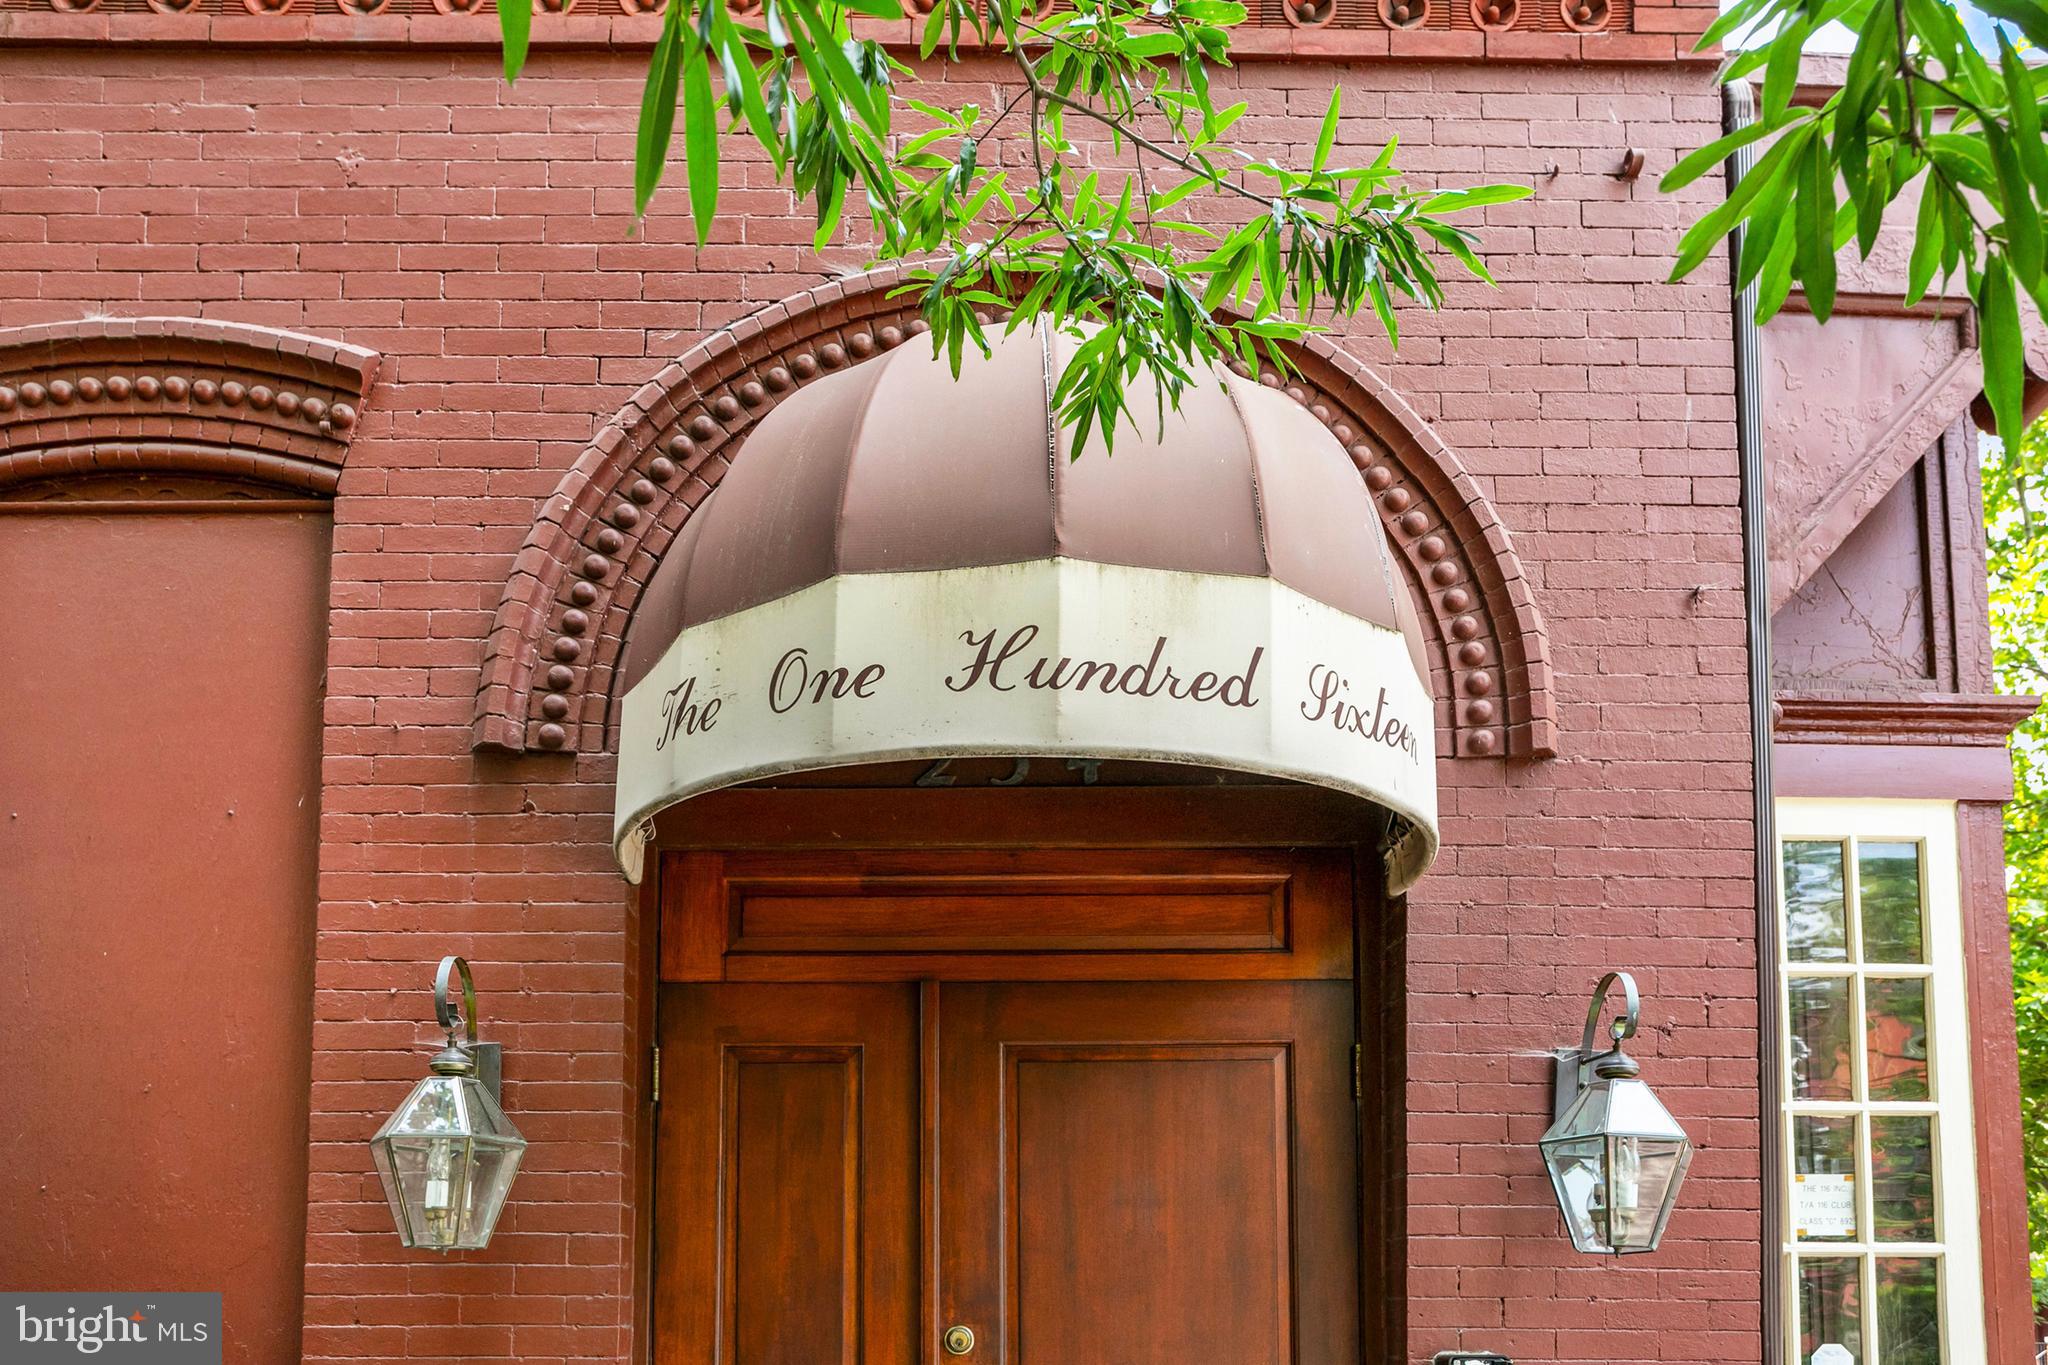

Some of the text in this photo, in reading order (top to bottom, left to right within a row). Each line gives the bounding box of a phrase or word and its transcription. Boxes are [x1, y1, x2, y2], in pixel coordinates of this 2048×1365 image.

[656, 624, 1419, 766] The One Hundred Sixteen
[1803, 1185, 1817, 1193] THE
[1831, 1201, 1852, 1209] CLUB
